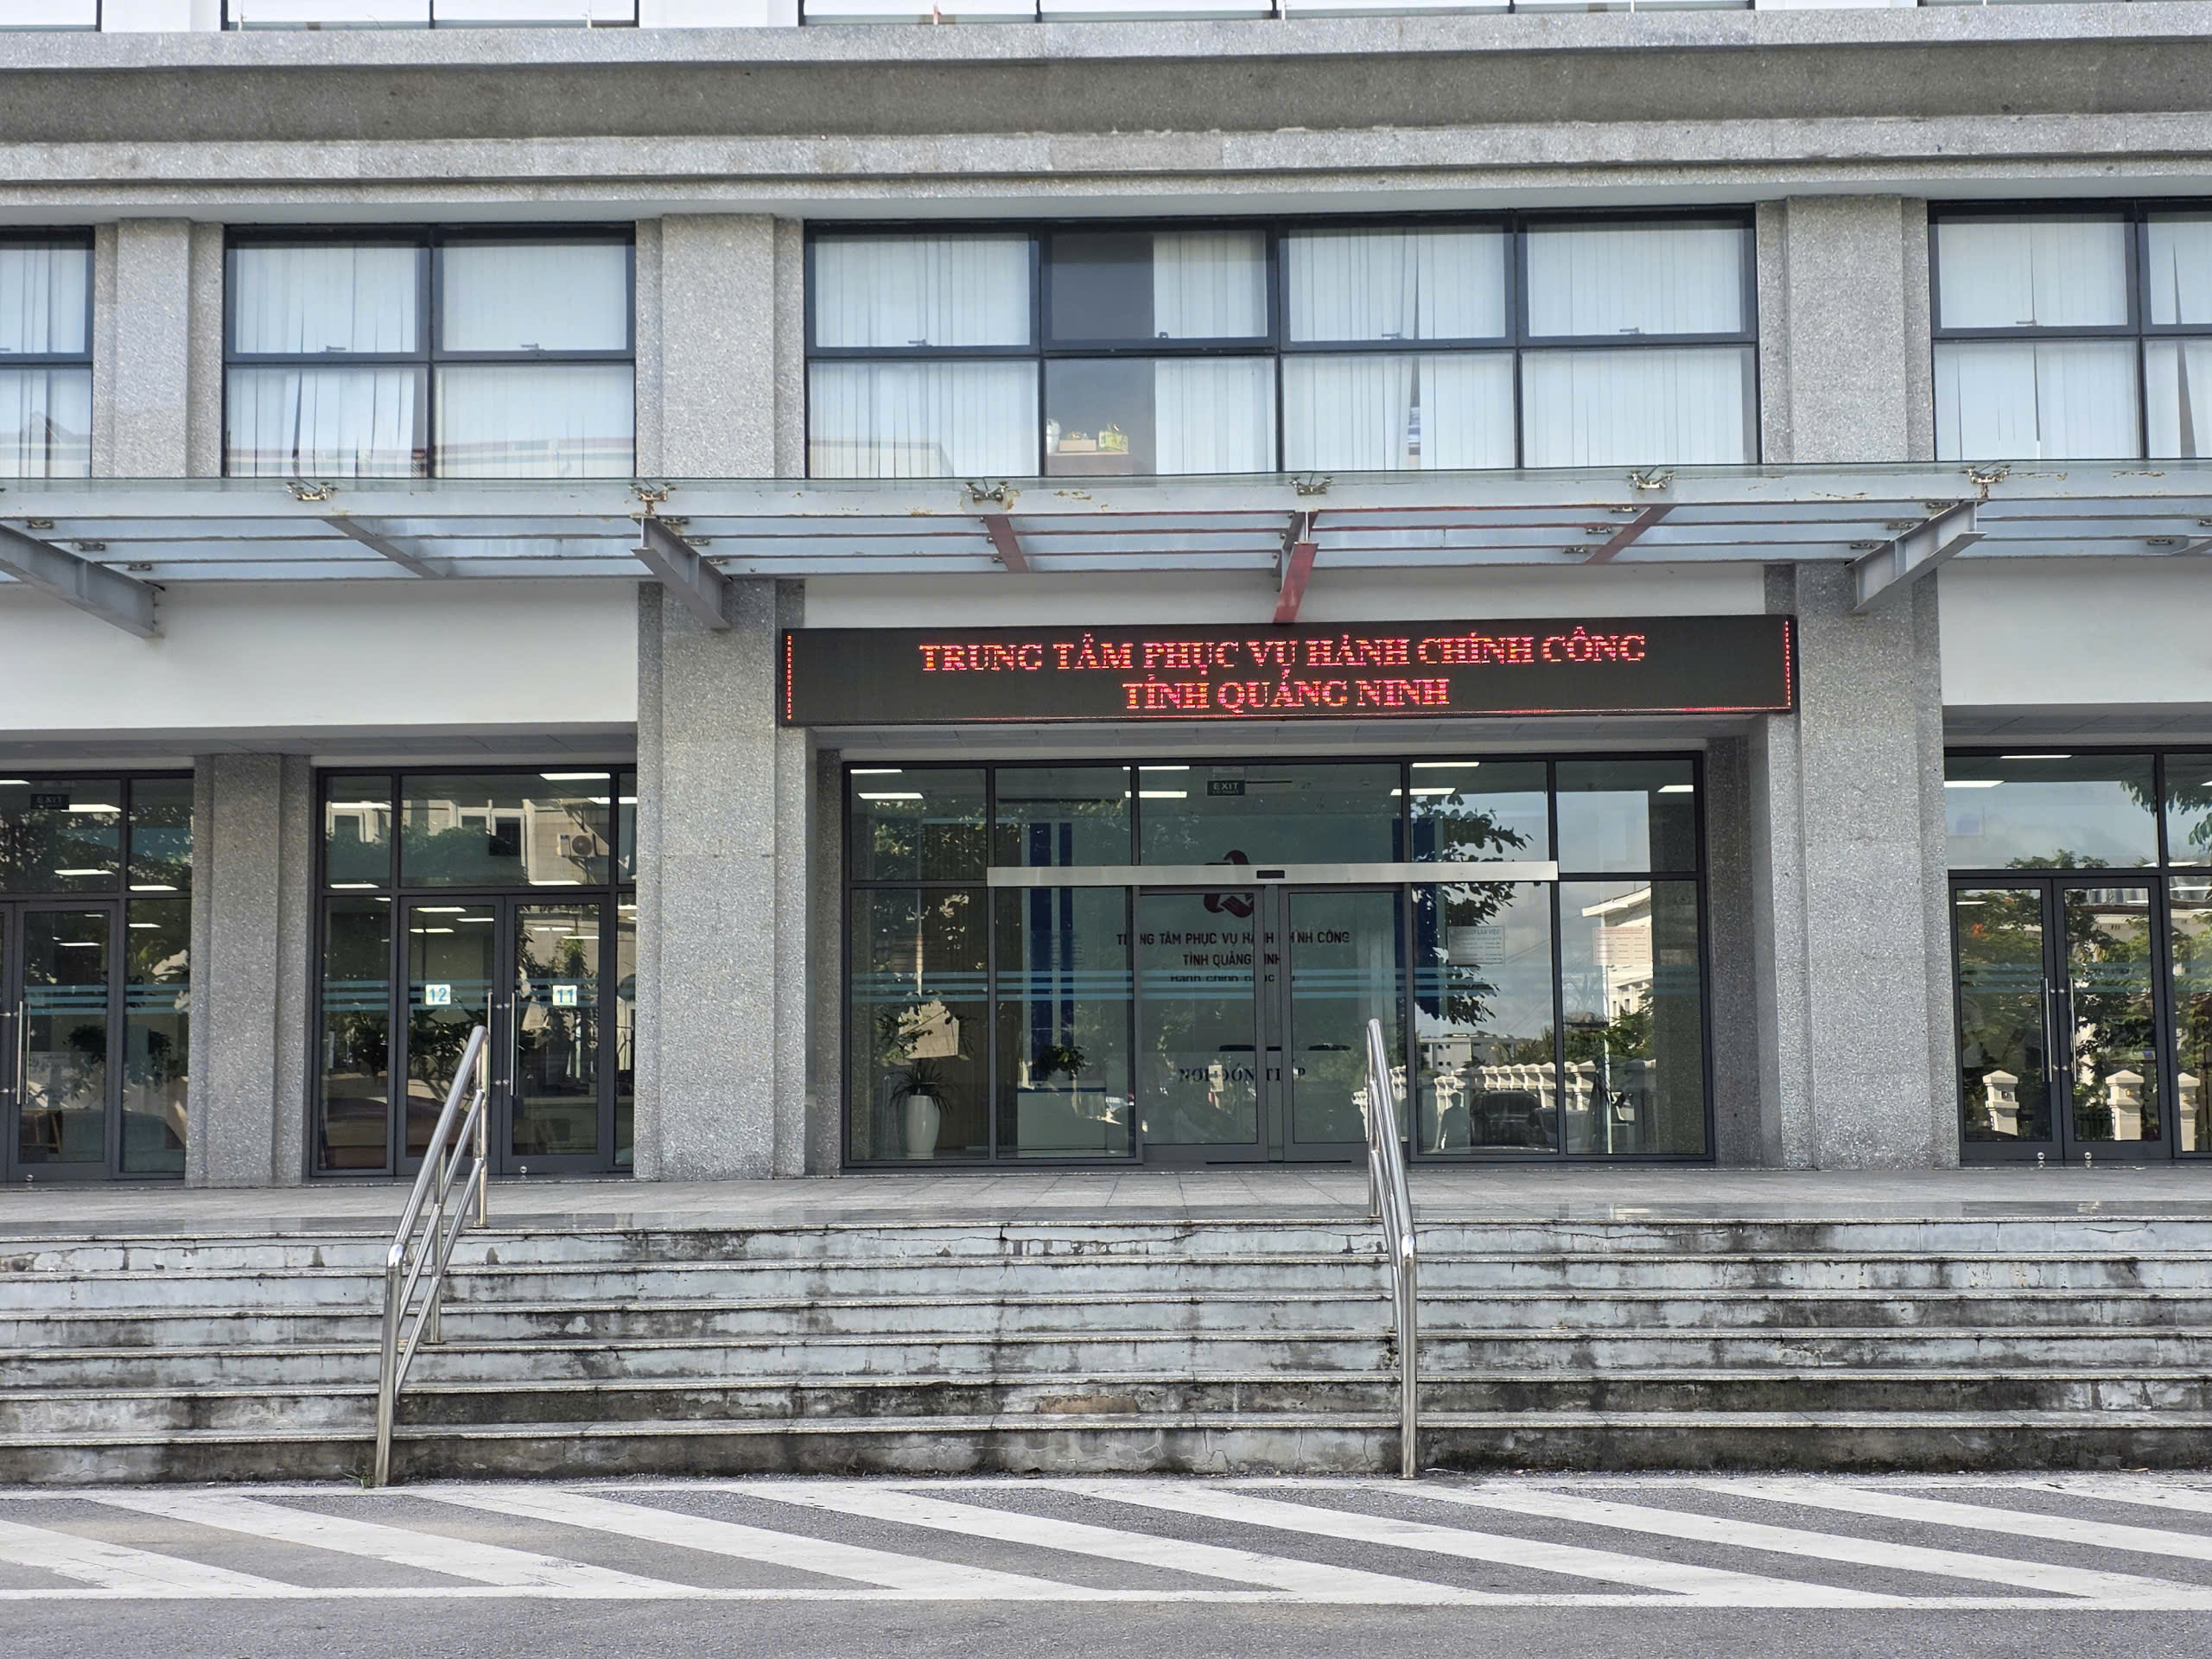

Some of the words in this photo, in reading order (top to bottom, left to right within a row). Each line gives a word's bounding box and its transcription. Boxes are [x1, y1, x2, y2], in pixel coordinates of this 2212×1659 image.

[918, 643, 1043, 671] TRUNG
[1052, 632, 1134, 670] TÂM
[1143, 640, 1239, 676] PHỤC
[1246, 639, 1298, 674] VỤ
[1418, 632, 1535, 664] CHÍNH
[1541, 626, 1645, 662] CÔNG
[1217, 671, 1348, 715] QUẢNG
[1355, 678, 1450, 707] NINH
[1116, 934, 1154, 945] TNG
[1160, 931, 1181, 944] TÂM
[1185, 932, 1217, 947] PHỤC
[1223, 932, 1237, 947] VỤ
[1317, 929, 1350, 944] CÔNG
[1213, 950, 1252, 968] QUẢNG
[1262, 952, 1281, 965] INH
[429, 988, 447, 1002] 12
[556, 988, 574, 1003] 11
[1266, 1064, 1306, 1081] TIP
